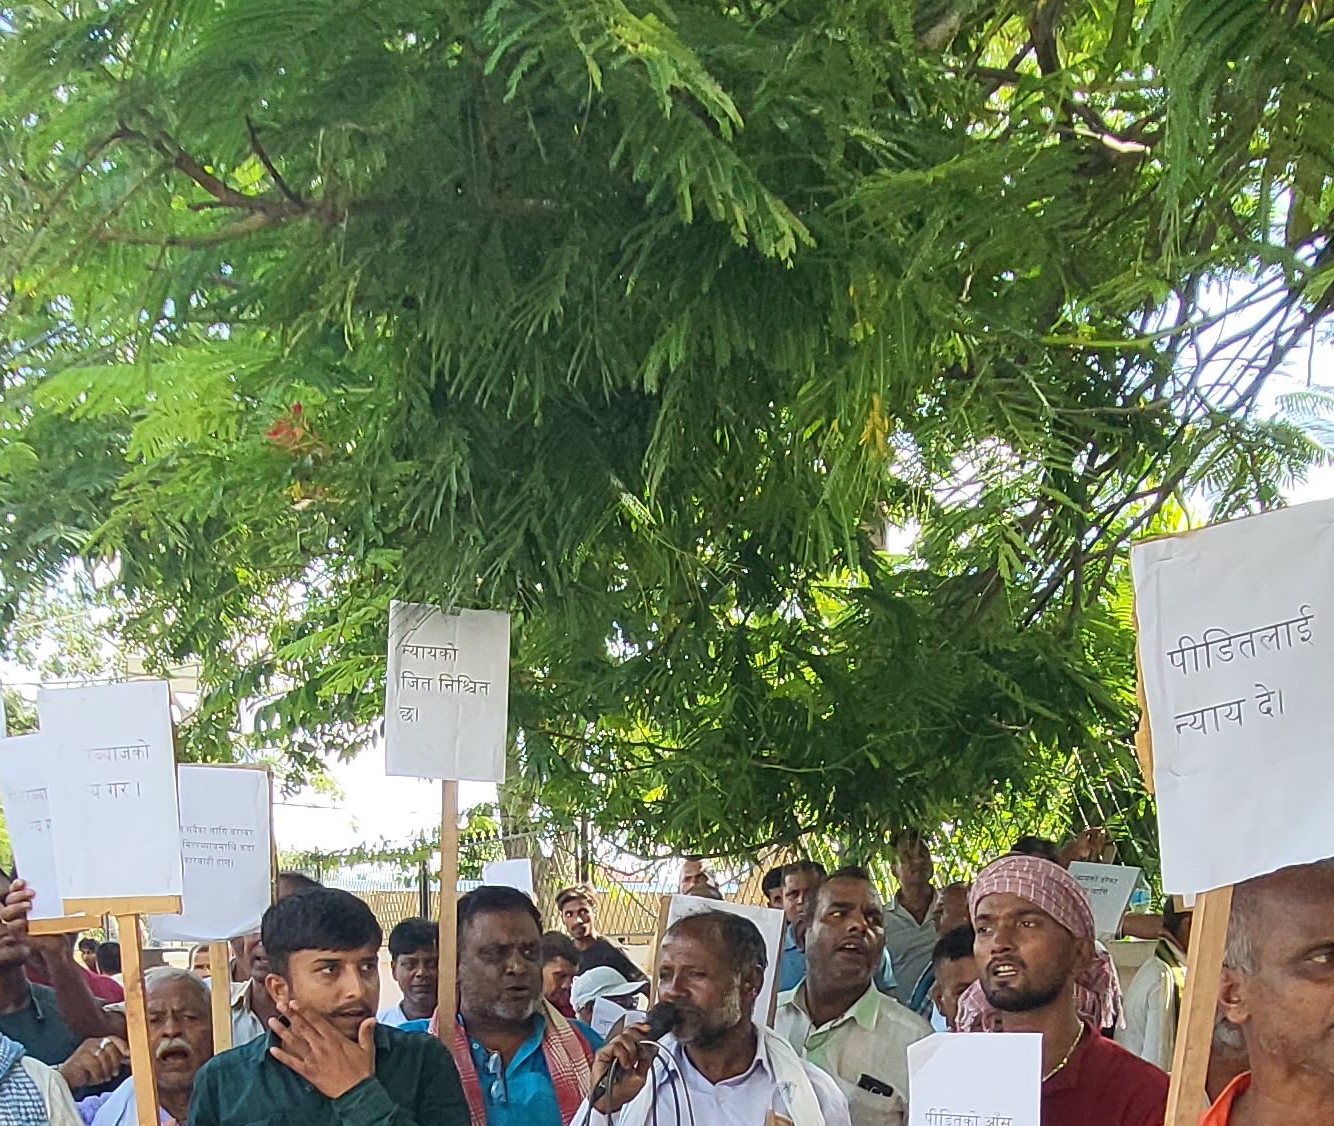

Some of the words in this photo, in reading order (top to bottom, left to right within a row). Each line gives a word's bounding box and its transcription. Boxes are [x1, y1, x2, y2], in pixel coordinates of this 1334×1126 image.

[402, 643, 459, 662] न्यायको
[1167, 605, 1315, 675] पीडितलाई
[401, 671, 432, 691] जित
[438, 674, 491, 695] निश्चित
[1173, 699, 1246, 735] न्याय
